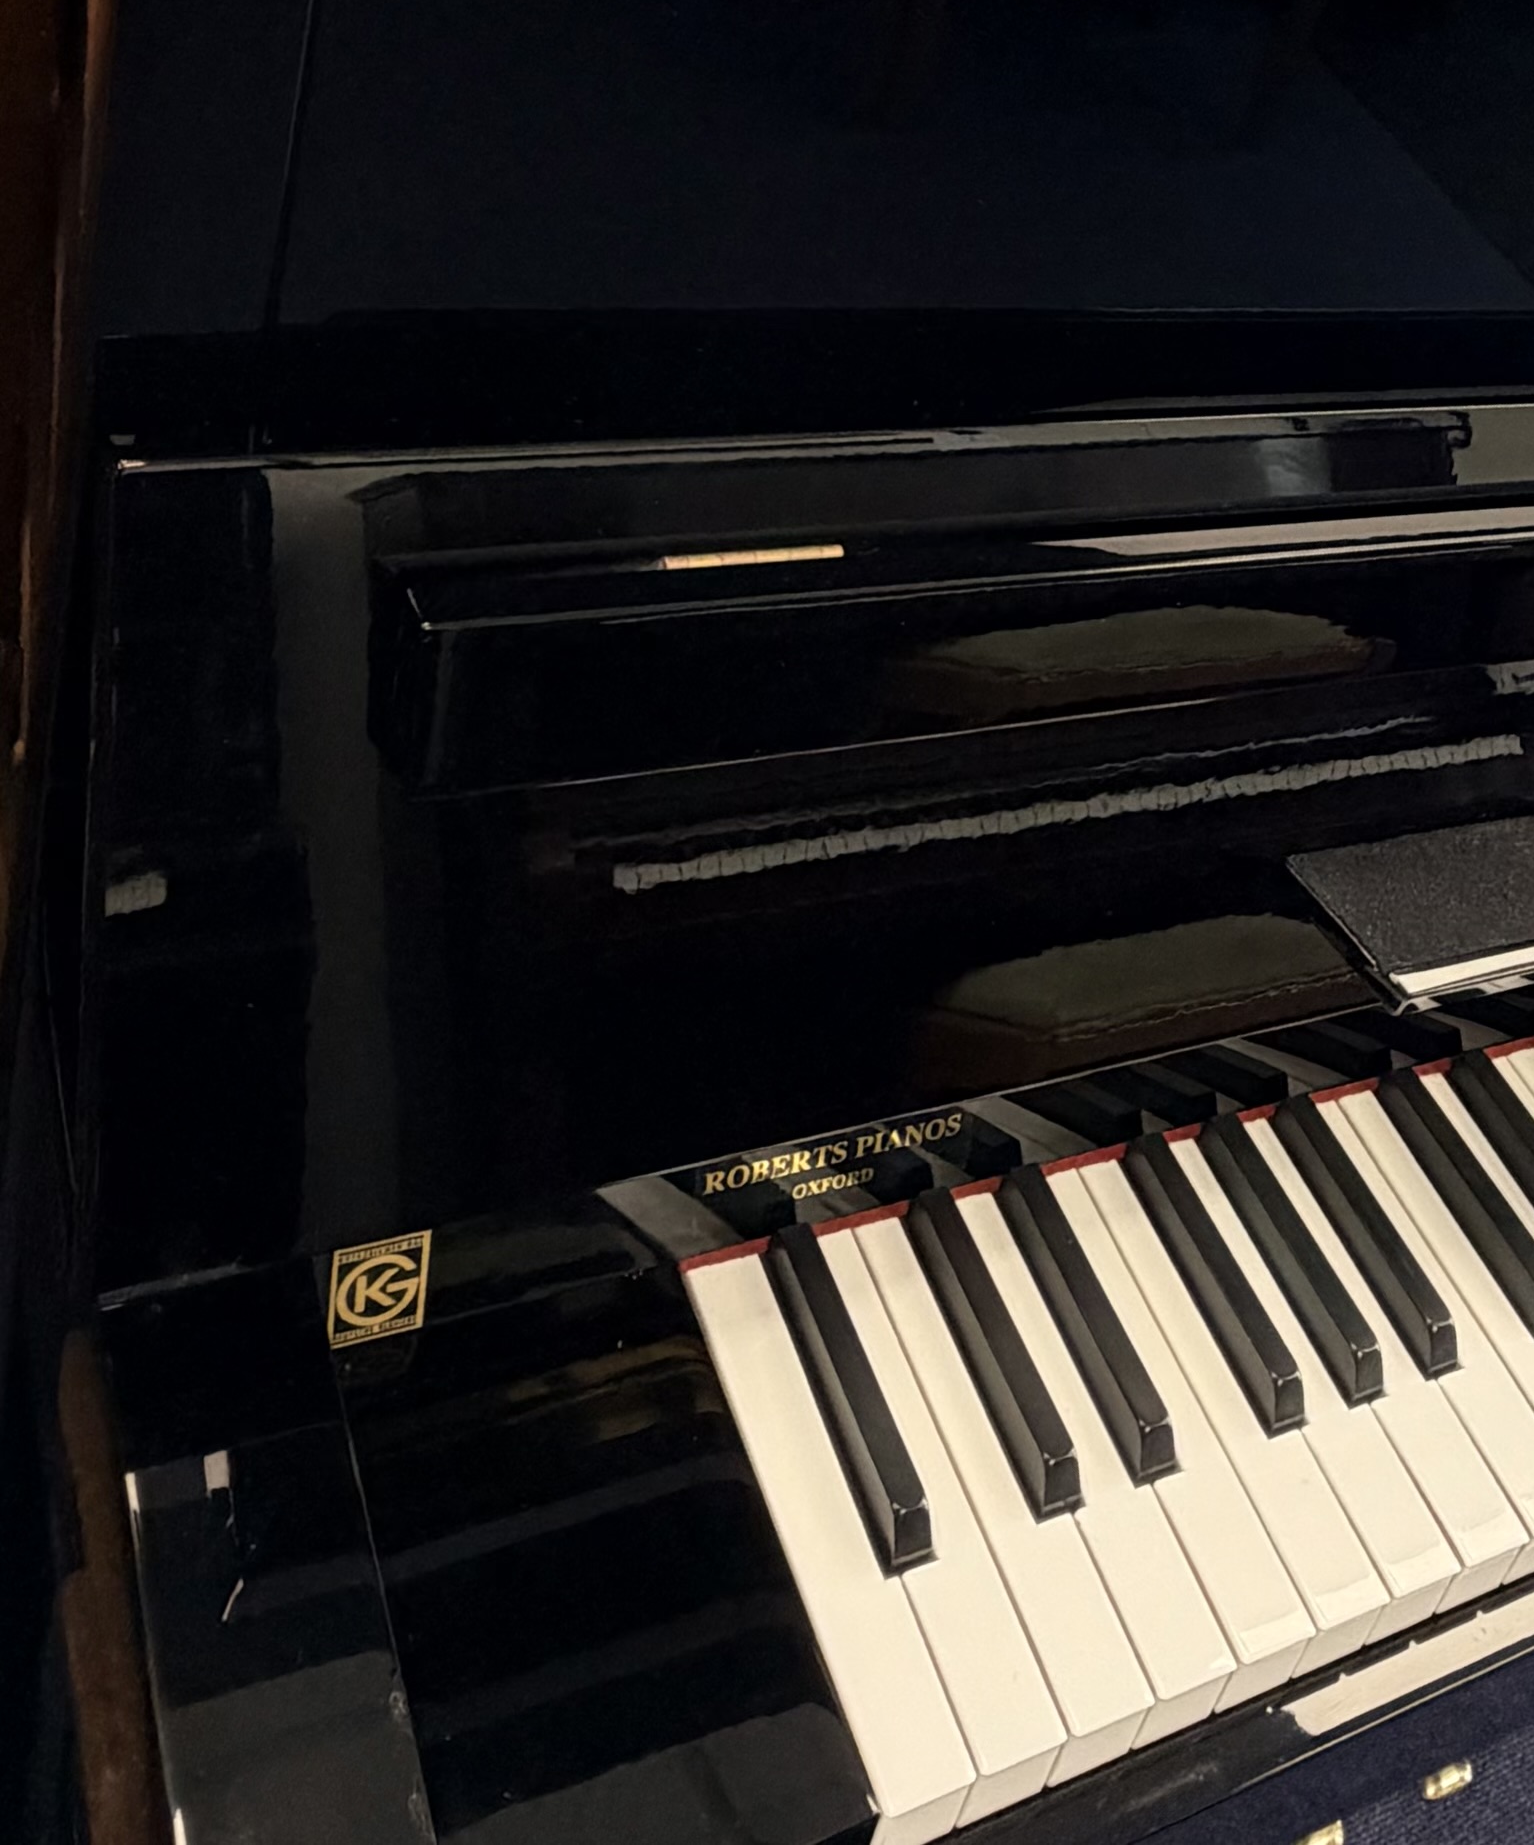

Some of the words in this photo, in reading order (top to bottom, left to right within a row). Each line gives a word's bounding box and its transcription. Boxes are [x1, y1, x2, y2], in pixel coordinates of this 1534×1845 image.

[702, 1139, 849, 1196] ROBERTS
[854, 1112, 963, 1160] PIANOS
[791, 1166, 875, 1201] OXFORD
